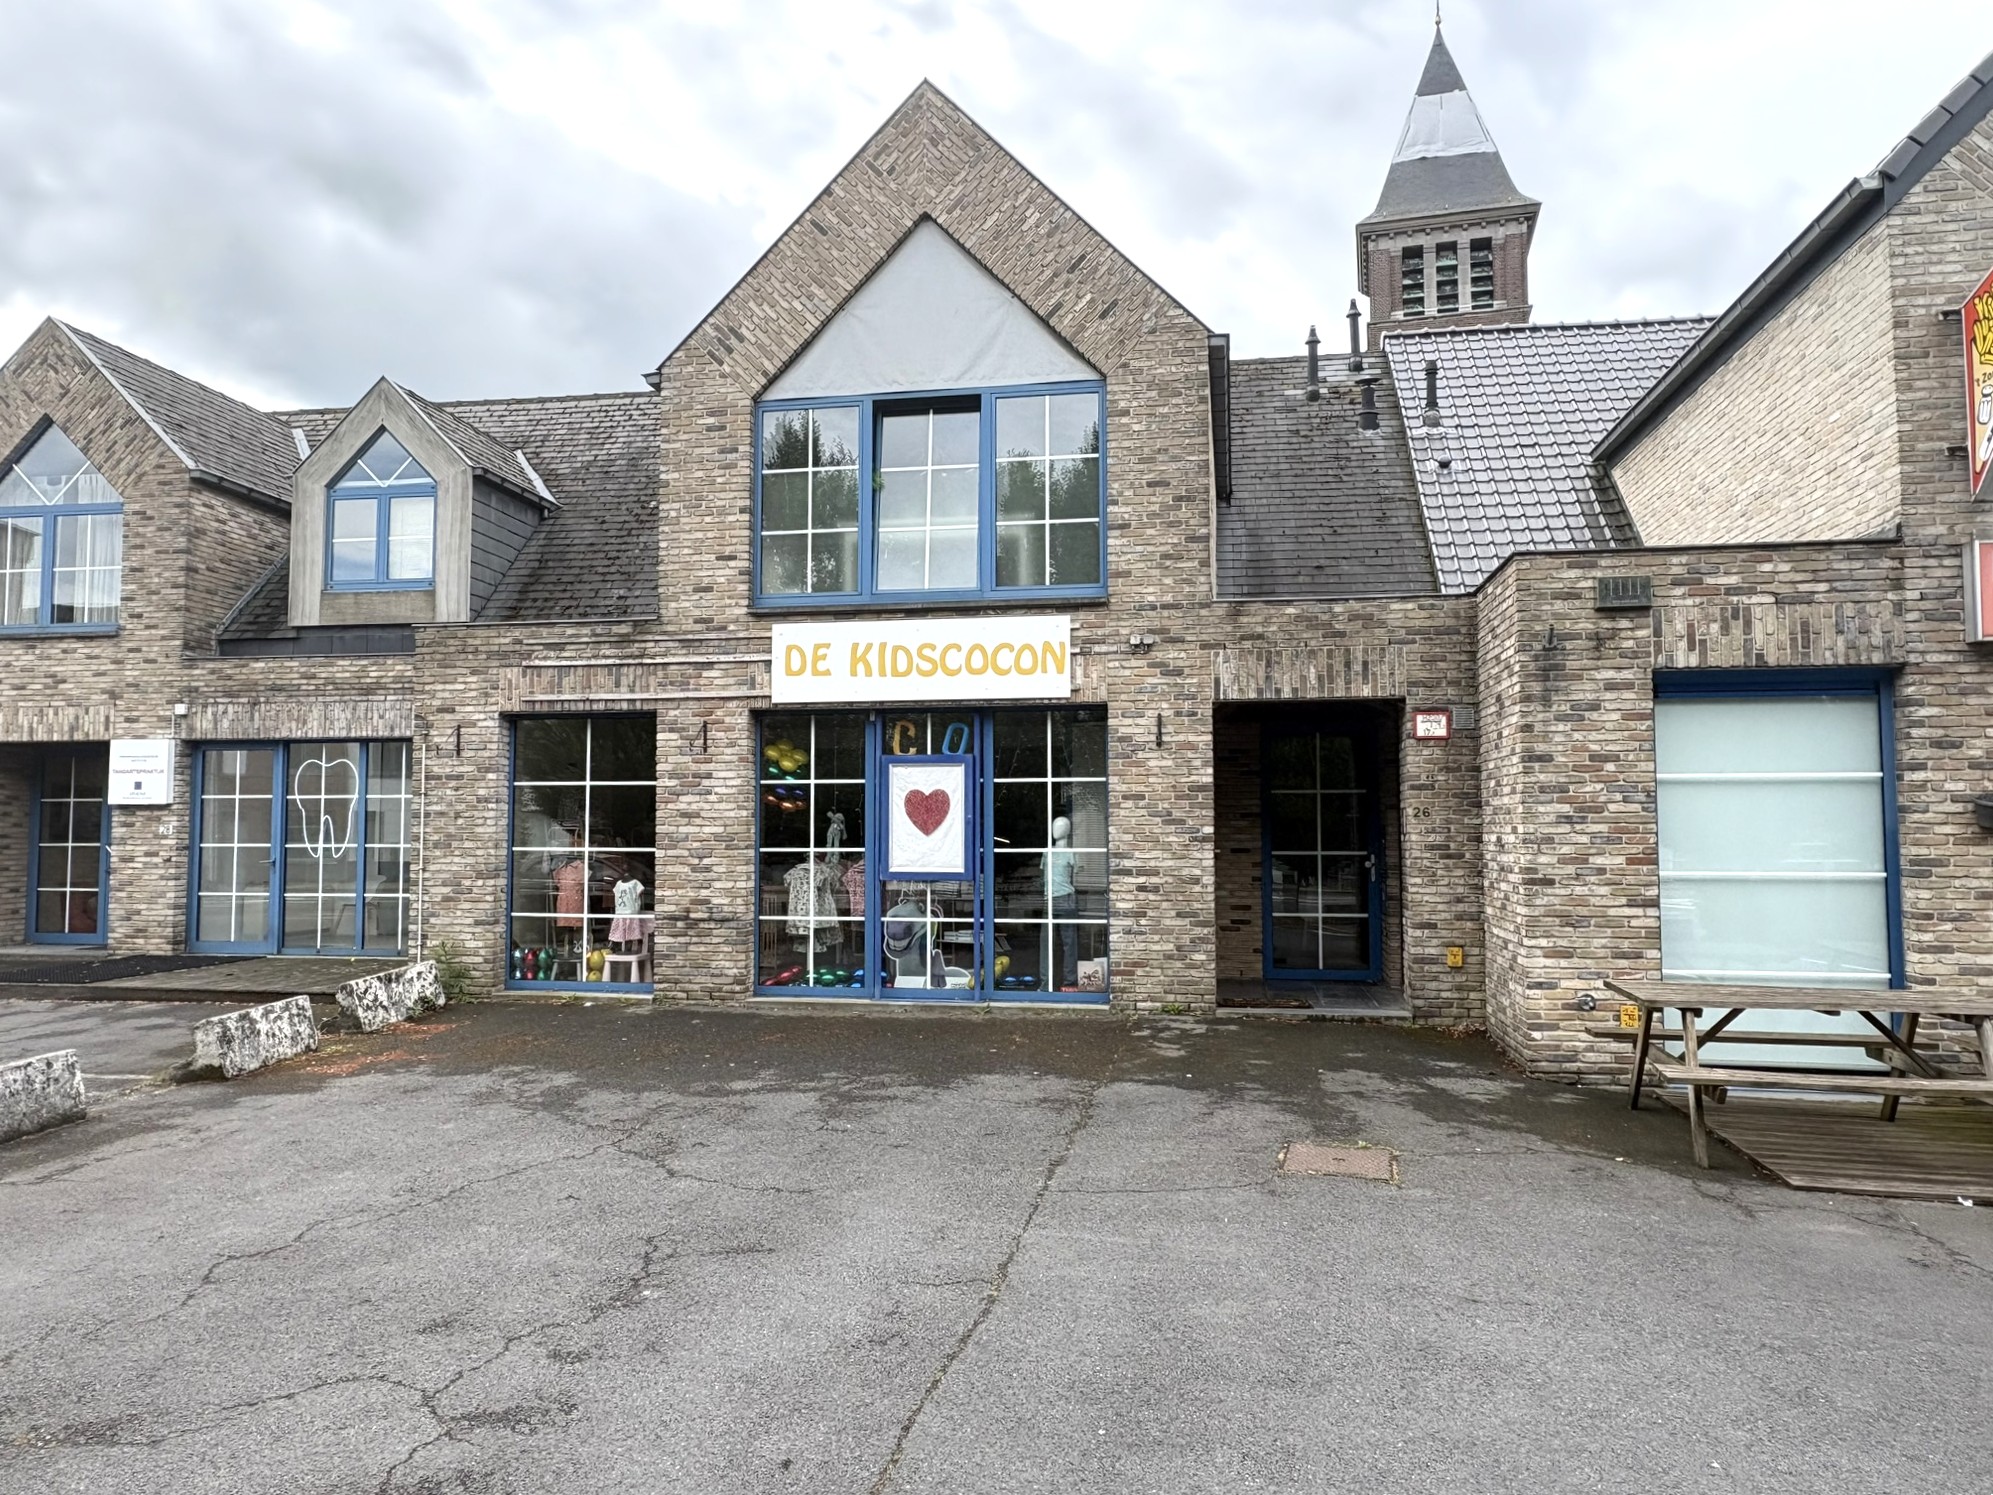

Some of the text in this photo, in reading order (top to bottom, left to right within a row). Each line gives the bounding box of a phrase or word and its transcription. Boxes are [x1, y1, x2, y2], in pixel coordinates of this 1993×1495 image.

[785, 640, 1066, 677] DE KIDSCOCON
[1413, 806, 1430, 818] 26
